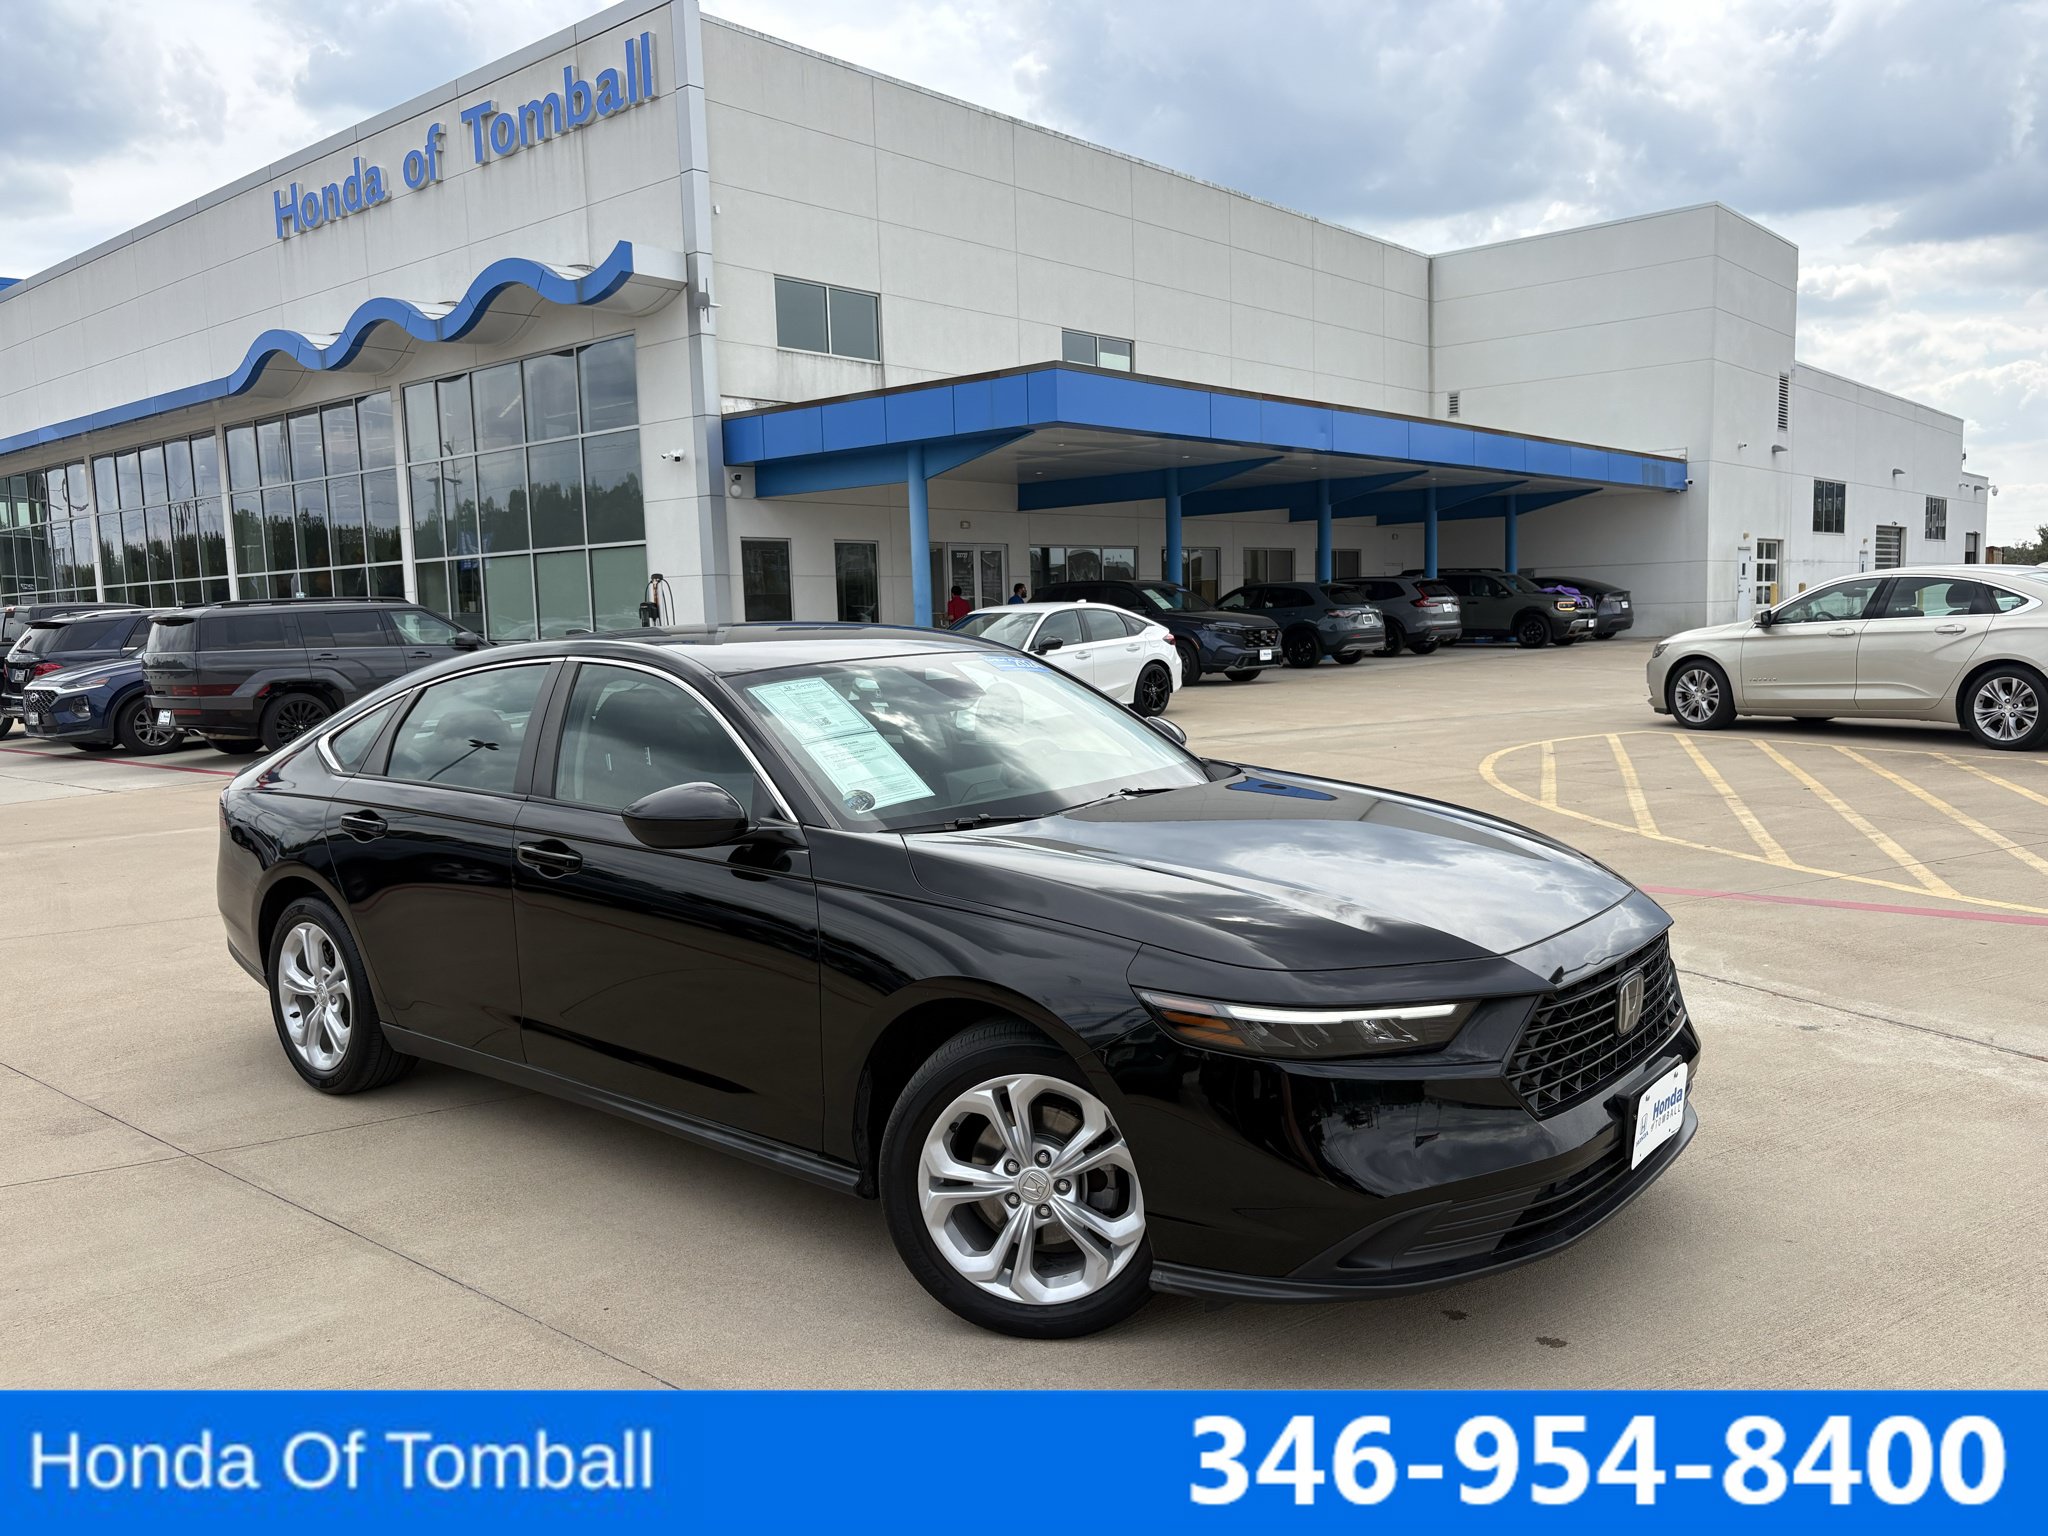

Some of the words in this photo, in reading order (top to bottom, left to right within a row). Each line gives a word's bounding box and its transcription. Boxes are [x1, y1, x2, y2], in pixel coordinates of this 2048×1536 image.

[274, 157, 392, 240] Honda
[403, 123, 446, 190] of
[461, 31, 658, 165] Tomball
[1653, 1087, 1683, 1120] Honda
[1655, 1104, 1681, 1128] TOMBALL
